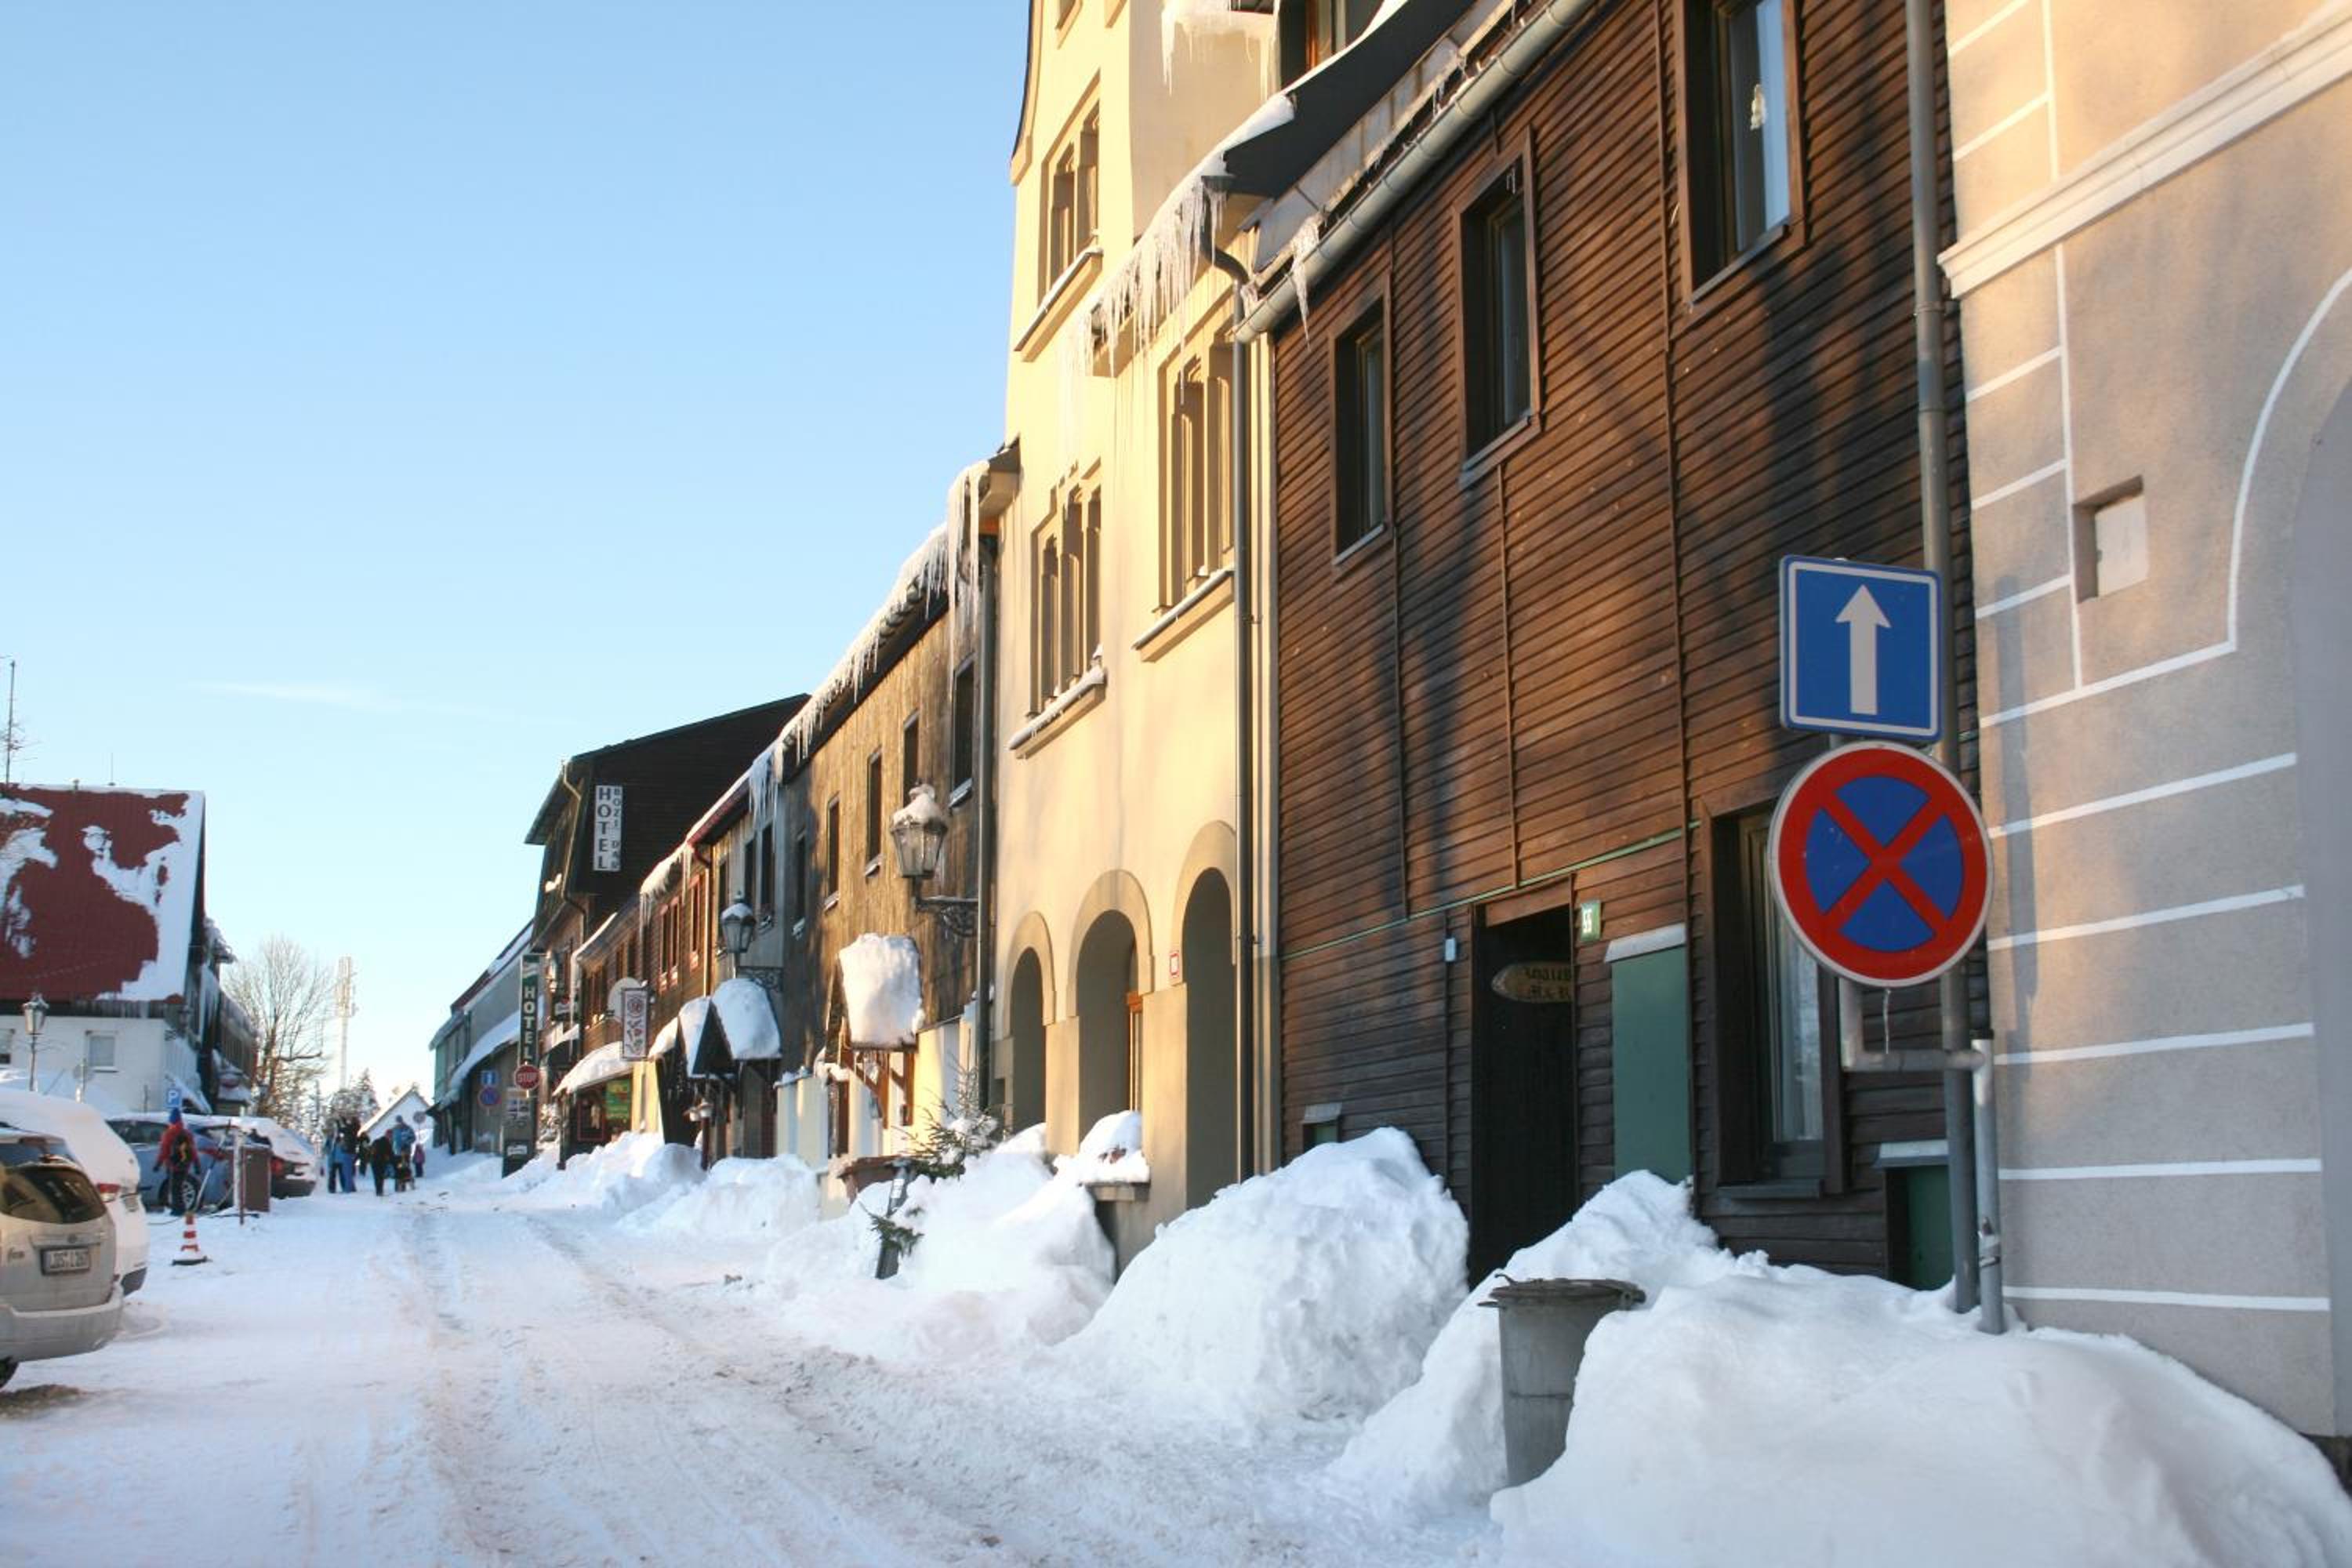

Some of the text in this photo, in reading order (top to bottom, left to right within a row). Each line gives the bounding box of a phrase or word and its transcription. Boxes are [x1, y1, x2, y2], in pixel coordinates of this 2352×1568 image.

[597, 787, 612, 869] HOTEL
[524, 985, 535, 1059] HOTEL
[168, 1090, 179, 1104] P
[517, 1072, 537, 1083] STOP
